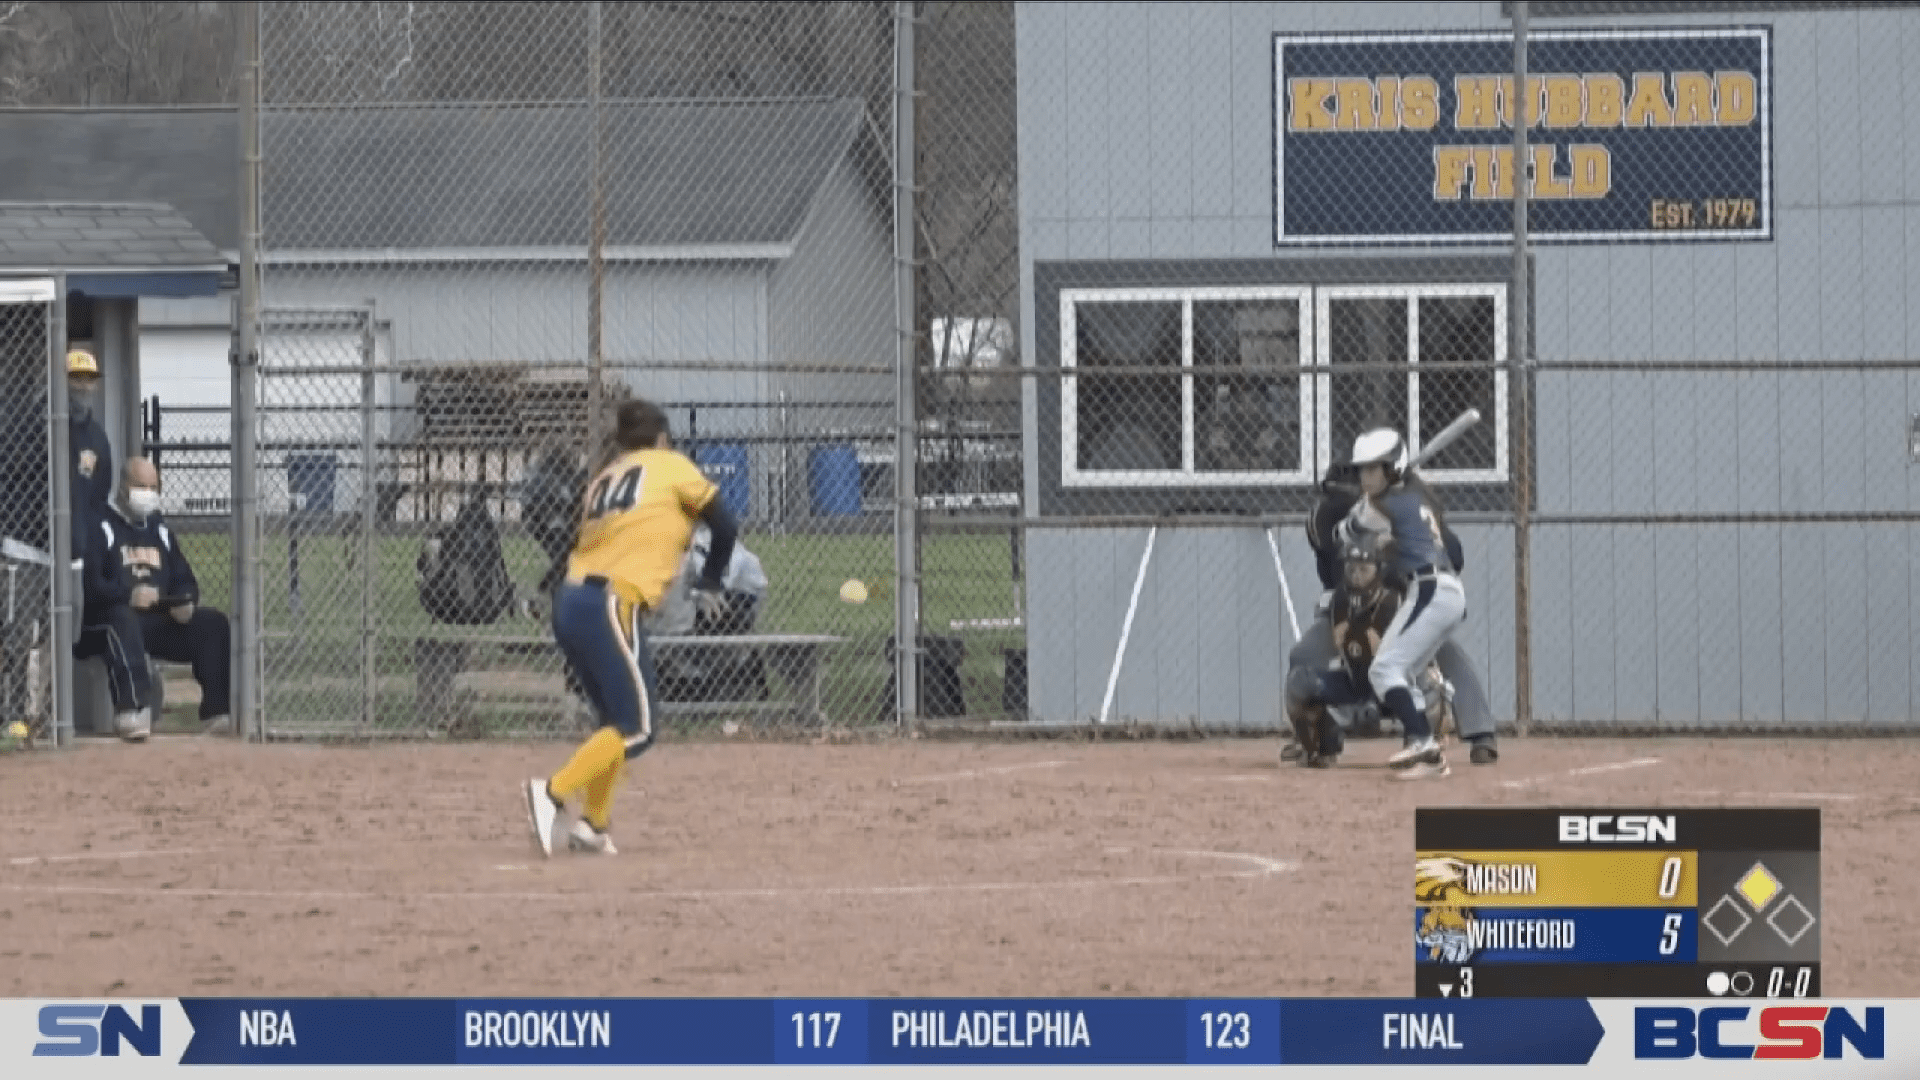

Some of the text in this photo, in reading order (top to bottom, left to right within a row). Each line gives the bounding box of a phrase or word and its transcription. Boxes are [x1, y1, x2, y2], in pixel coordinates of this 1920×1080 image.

[1289, 71, 1758, 132] KRIS HUBBARD
[1705, 198, 1757, 227] 1979
